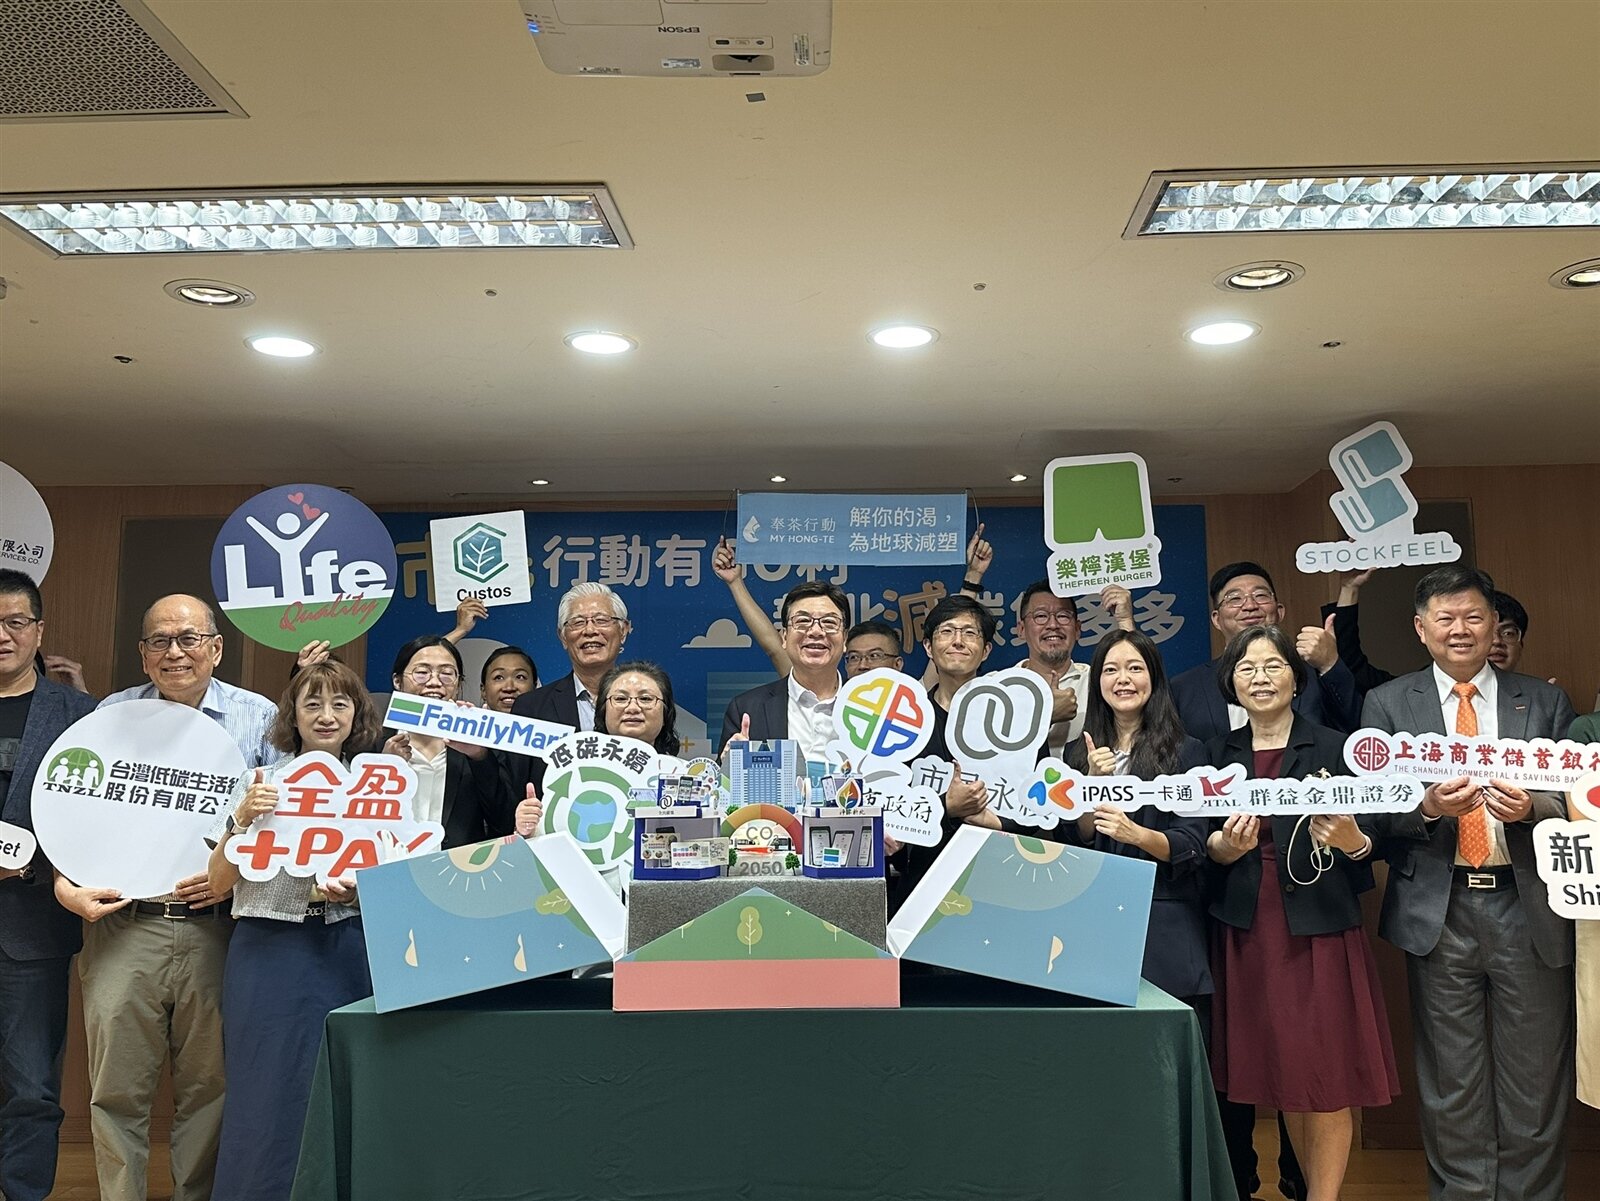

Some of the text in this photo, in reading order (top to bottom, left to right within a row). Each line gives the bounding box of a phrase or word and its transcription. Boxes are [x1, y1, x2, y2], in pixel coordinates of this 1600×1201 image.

[657, 26, 701, 34] EPSON
[769, 516, 837, 533] 奉茶行動
[0, 539, 44, 559] 限公司
[769, 534, 835, 544] MY HONG-TE
[848, 532, 959, 553] 為地球減塑
[1304, 540, 1453, 566] STOCKFEEL
[1055, 548, 1152, 580] 樂檸漢堡
[1058, 571, 1154, 590] THEFREEN BURGER
[456, 586, 512, 602] Custos
[279, 592, 379, 633] Quality
[421, 704, 569, 750] FamilyMar
[549, 736, 652, 775] 低碳永續
[1394, 764, 1409, 773] THE
[1412, 766, 1453, 776] SHANGHAI
[1457, 769, 1510, 780] COMMERCIAL
[1522, 773, 1561, 783] SAVINGS
[1564, 775, 1583, 784] BA
[43, 781, 102, 799] TNZL
[103, 781, 230, 816] 股份有限公
[274, 761, 408, 821] 全盈
[1082, 784, 1194, 802] iPASS 一卡通
[1248, 783, 1414, 807] 群益金鼎證券
[1549, 832, 1594, 875] 新
[740, 861, 783, 877] 2050
